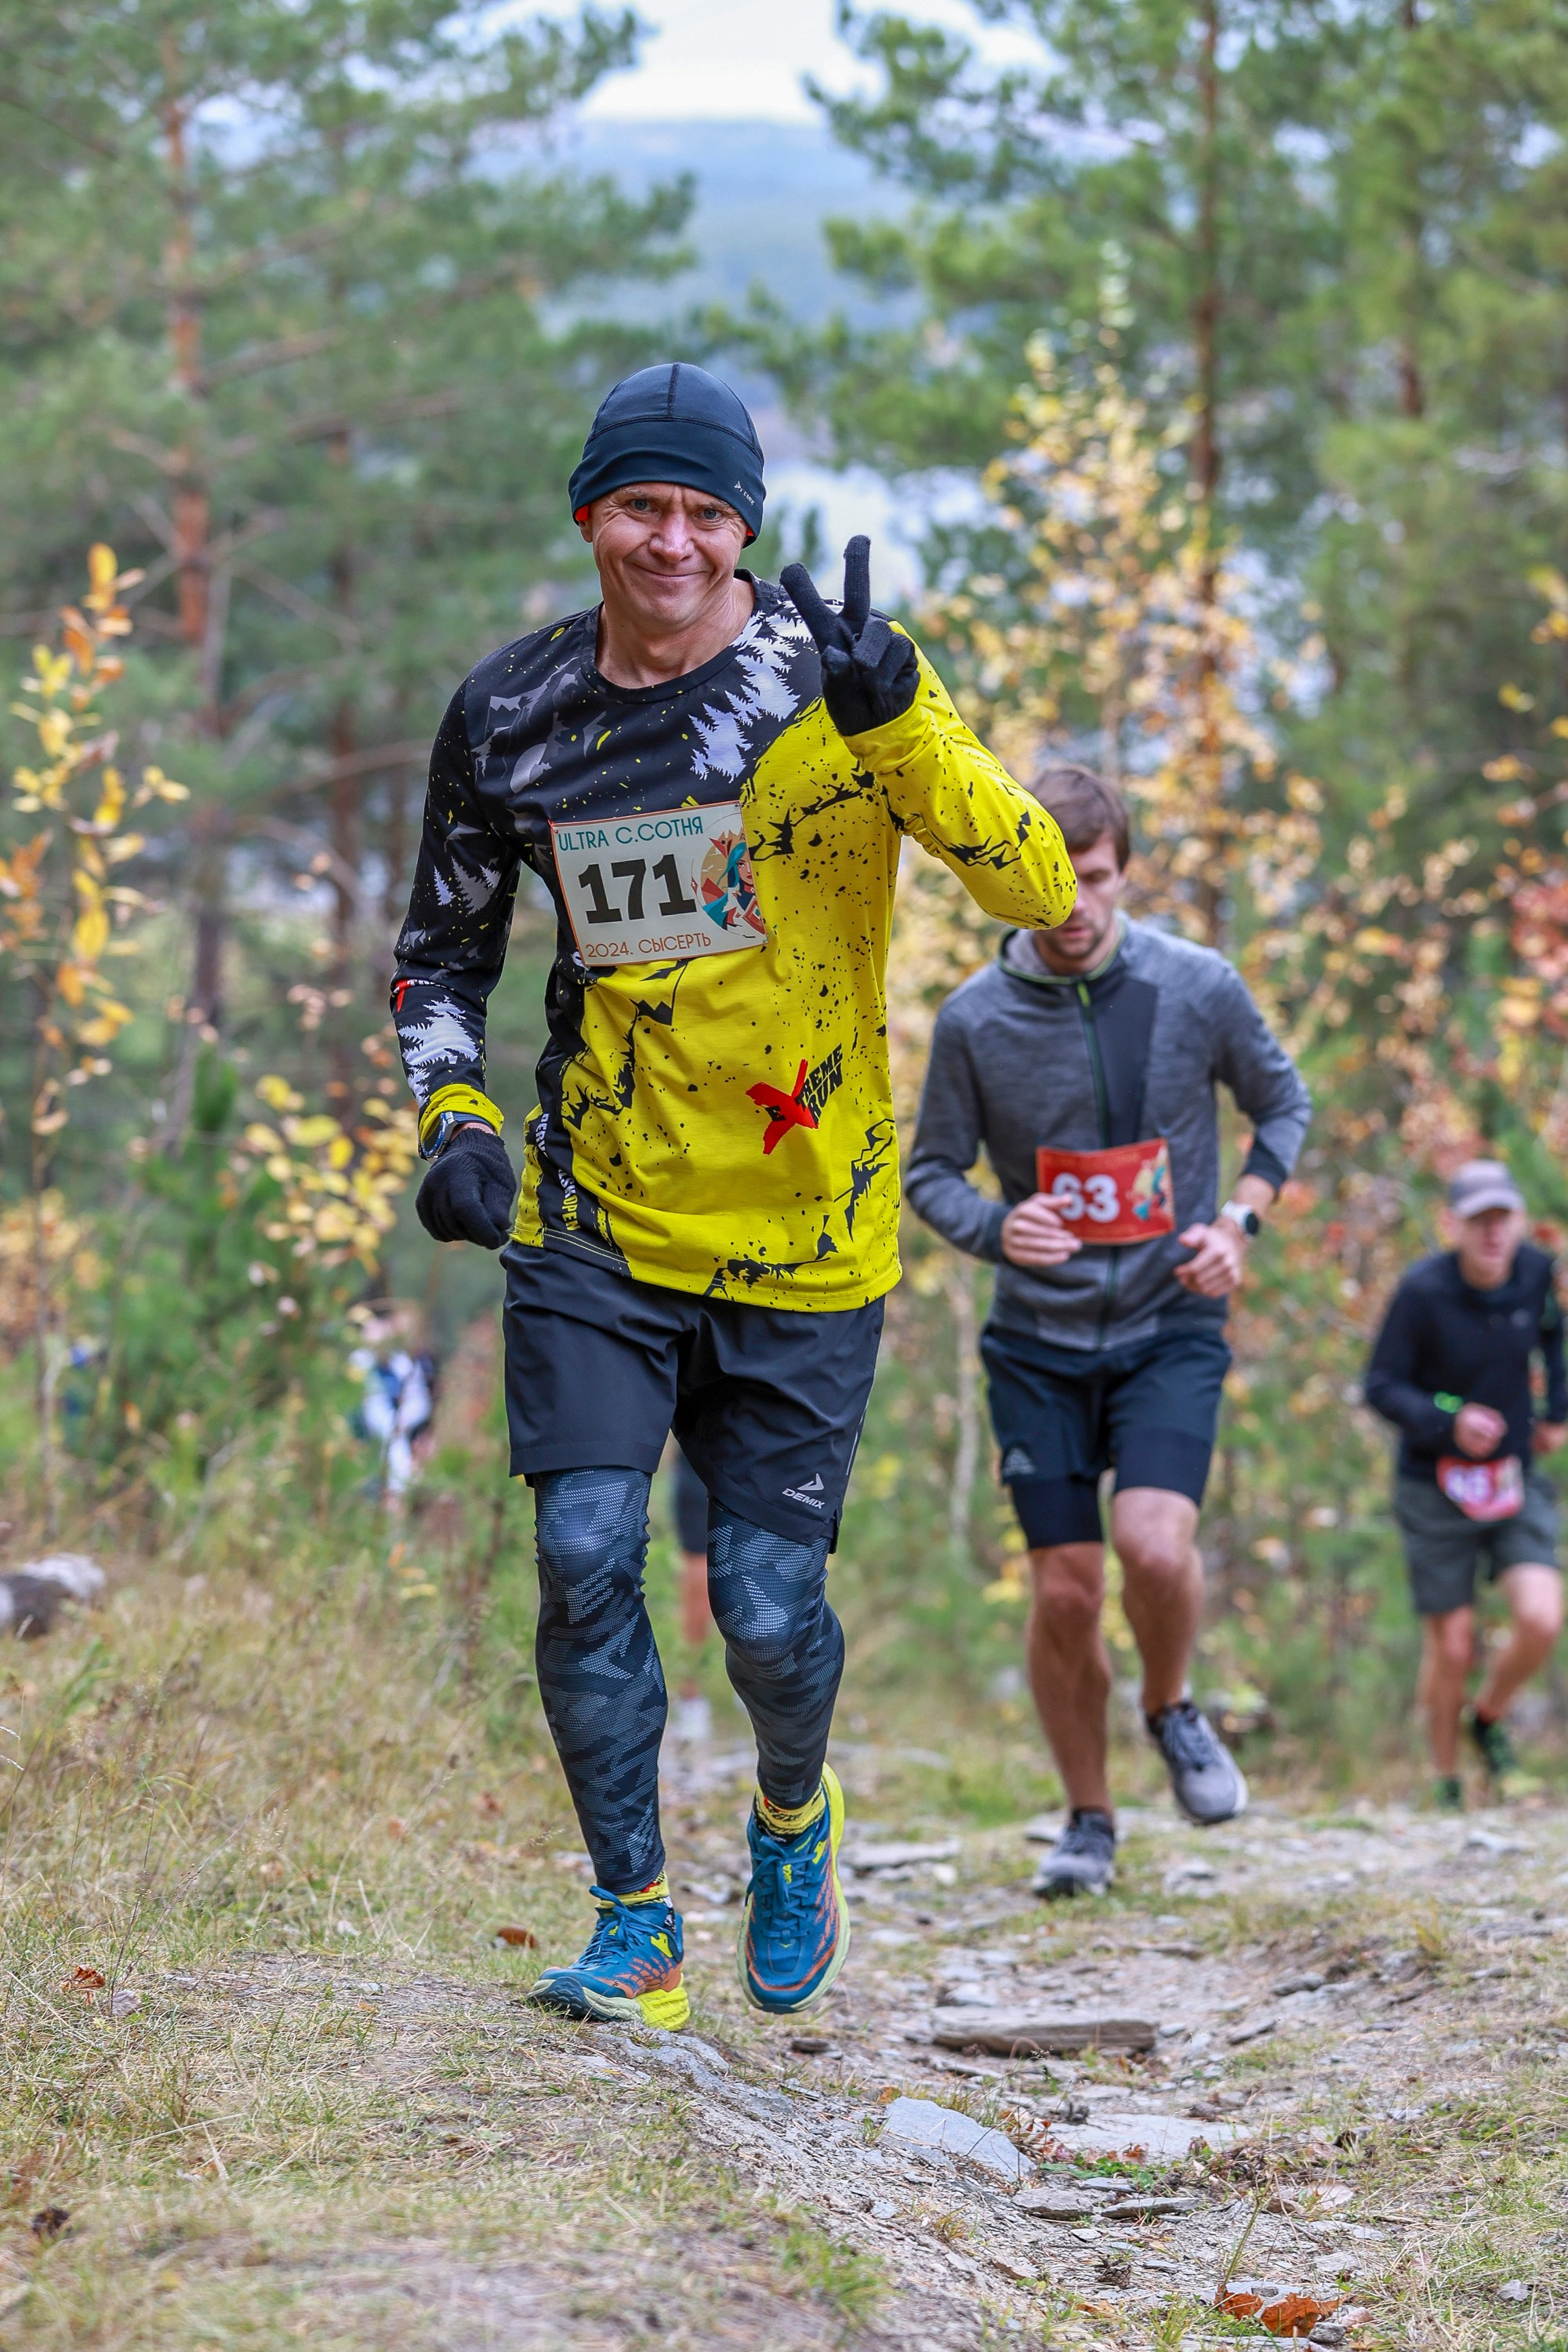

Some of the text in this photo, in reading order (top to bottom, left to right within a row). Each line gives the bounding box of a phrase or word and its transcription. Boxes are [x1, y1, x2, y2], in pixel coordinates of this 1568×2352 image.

[558, 816, 703, 851] ULTRA С.СОТНЯ
[578, 854, 697, 924] 171
[586, 933, 711, 958] 2024. СЫСЕРТЬ
[808, 1062, 843, 1126] RUN
[1051, 1172, 1120, 1222] 63
[782, 1488, 825, 1508] DEMIX
